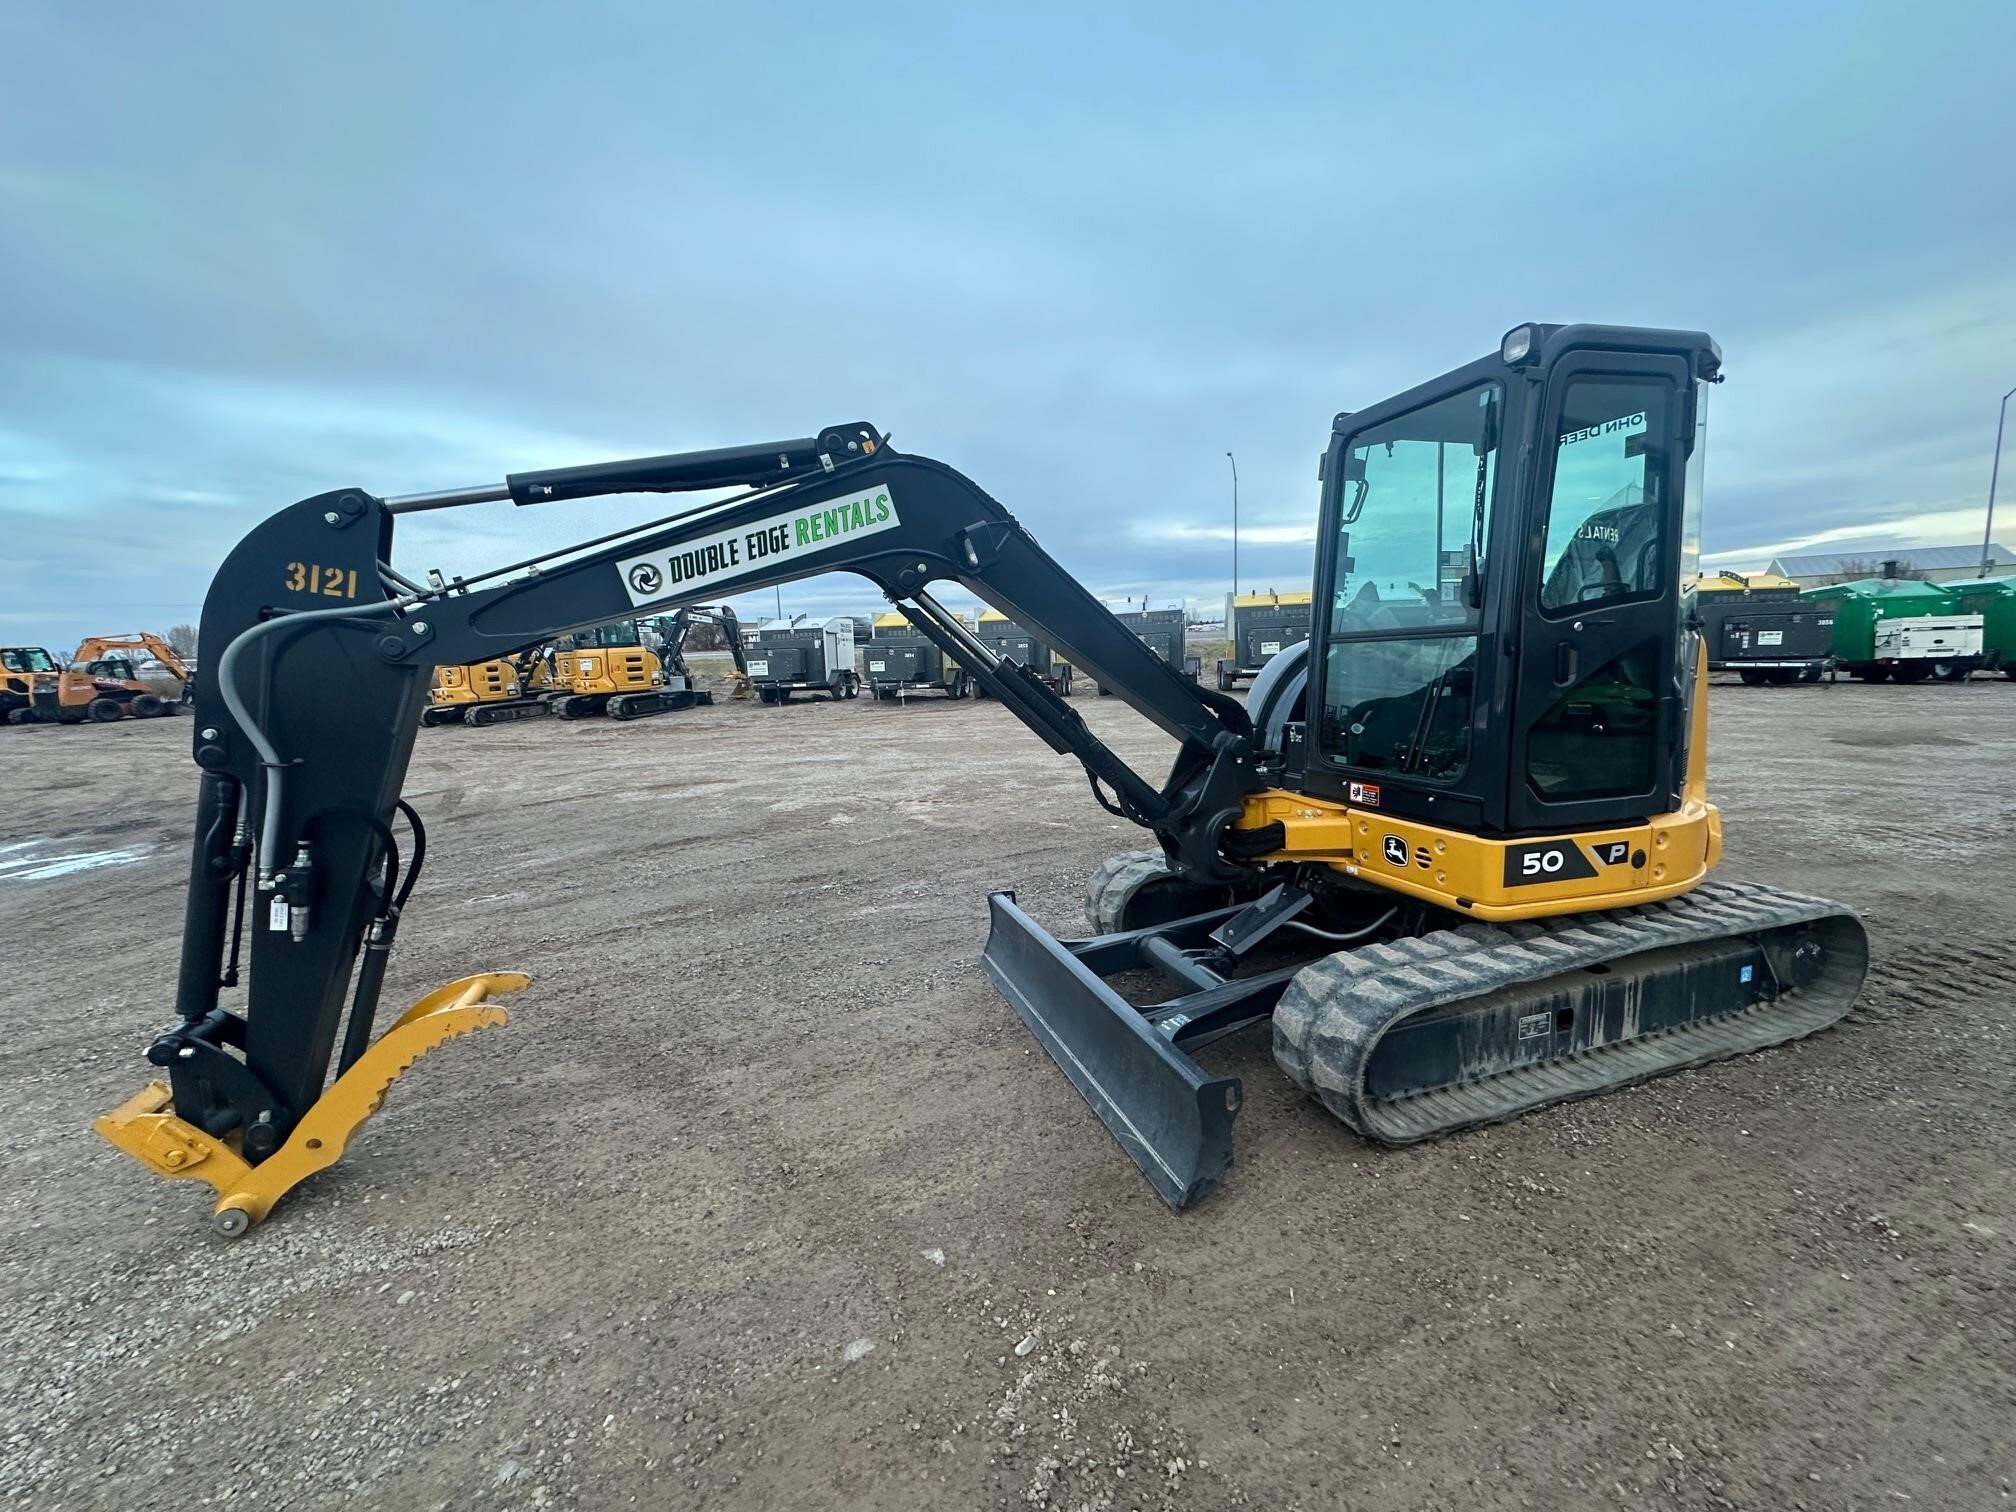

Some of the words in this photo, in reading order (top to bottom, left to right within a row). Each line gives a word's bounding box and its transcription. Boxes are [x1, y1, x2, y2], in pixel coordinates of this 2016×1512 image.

[668, 538, 740, 584] DOUBLE
[745, 523, 790, 561] EDGE
[794, 493, 890, 547] RENTALS
[285, 562, 357, 598] 3121
[95, 676, 127, 686] CASE
[1522, 850, 1564, 875] 50
[1608, 844, 1626, 863] P
